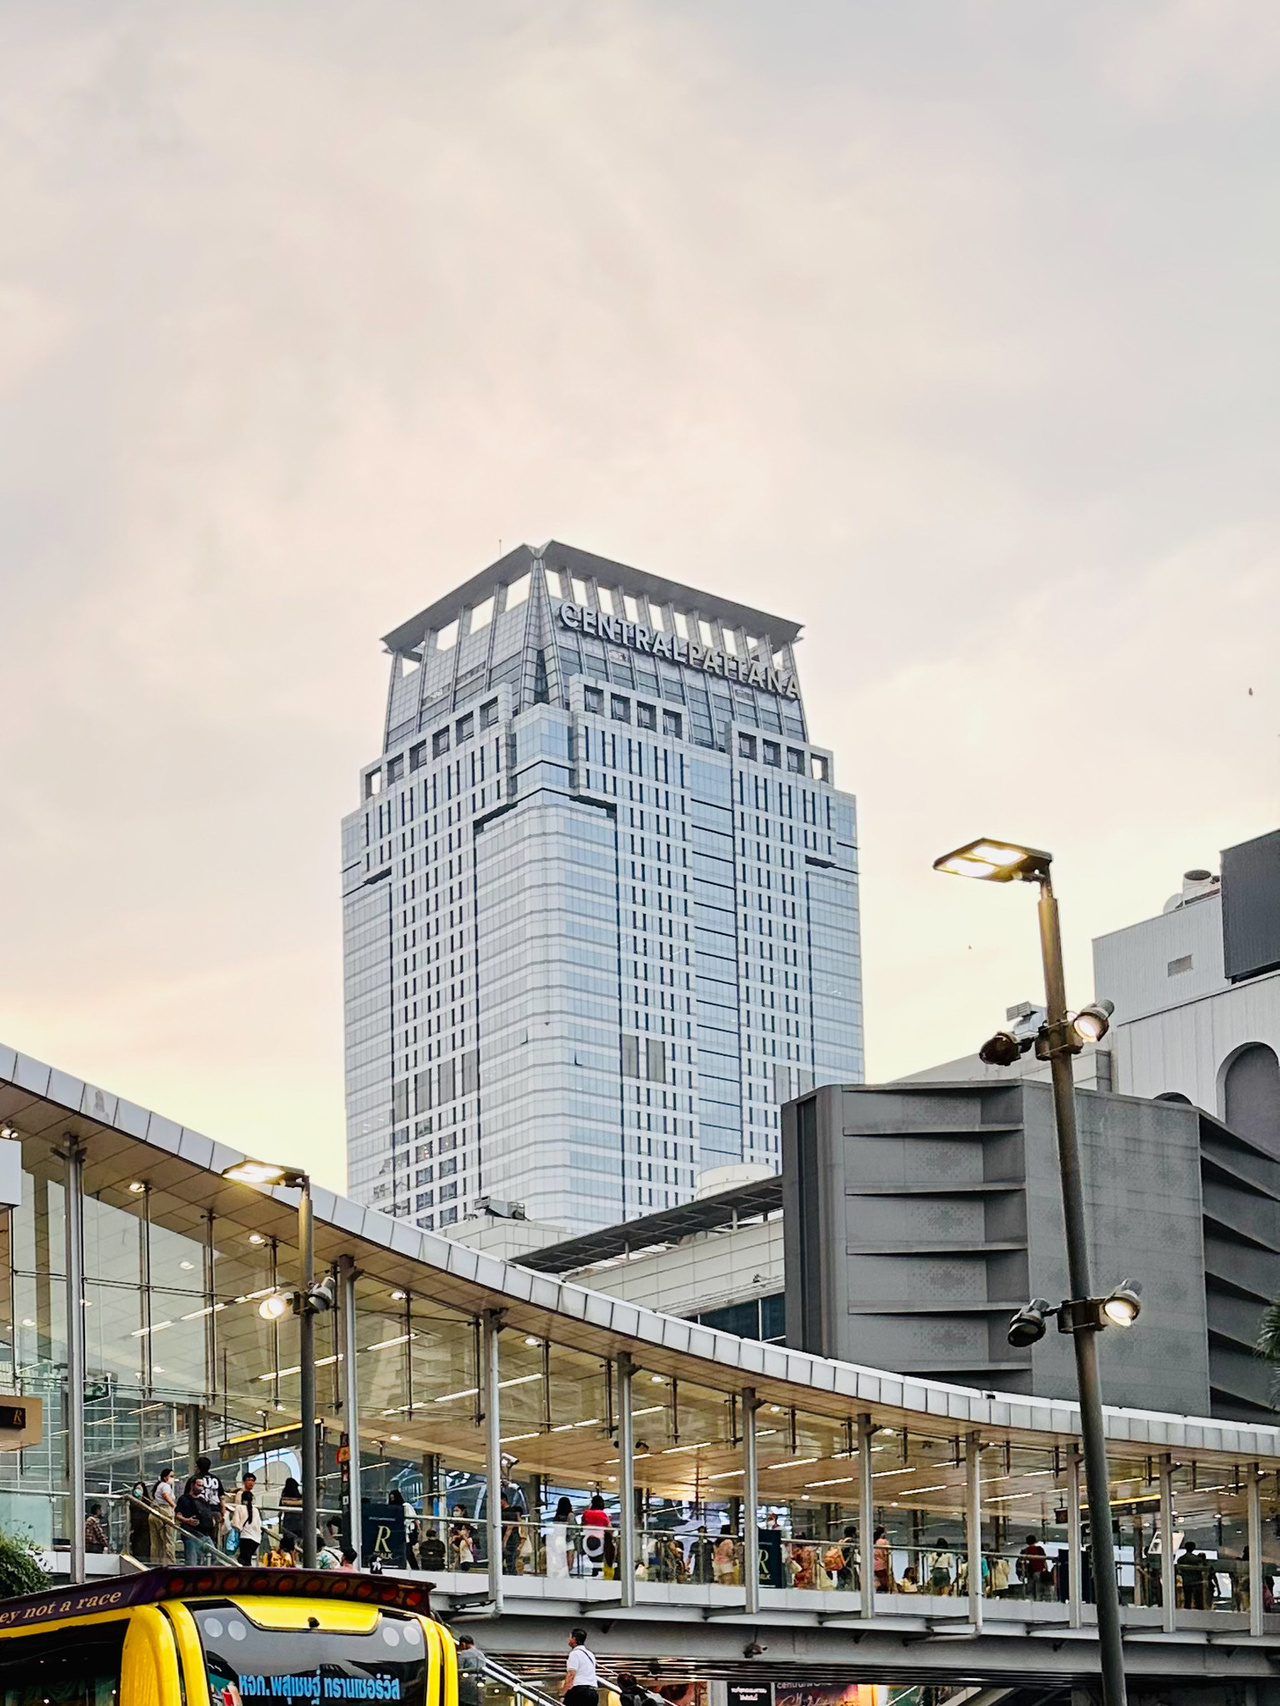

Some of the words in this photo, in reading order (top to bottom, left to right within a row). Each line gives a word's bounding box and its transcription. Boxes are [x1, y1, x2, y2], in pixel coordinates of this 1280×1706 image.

[559, 602, 800, 700] CENTRALPATTANA
[374, 1525, 392, 1553] R
[22, 1602, 55, 1620] not
[59, 1600, 71, 1613] a
[76, 1590, 122, 1610] race
